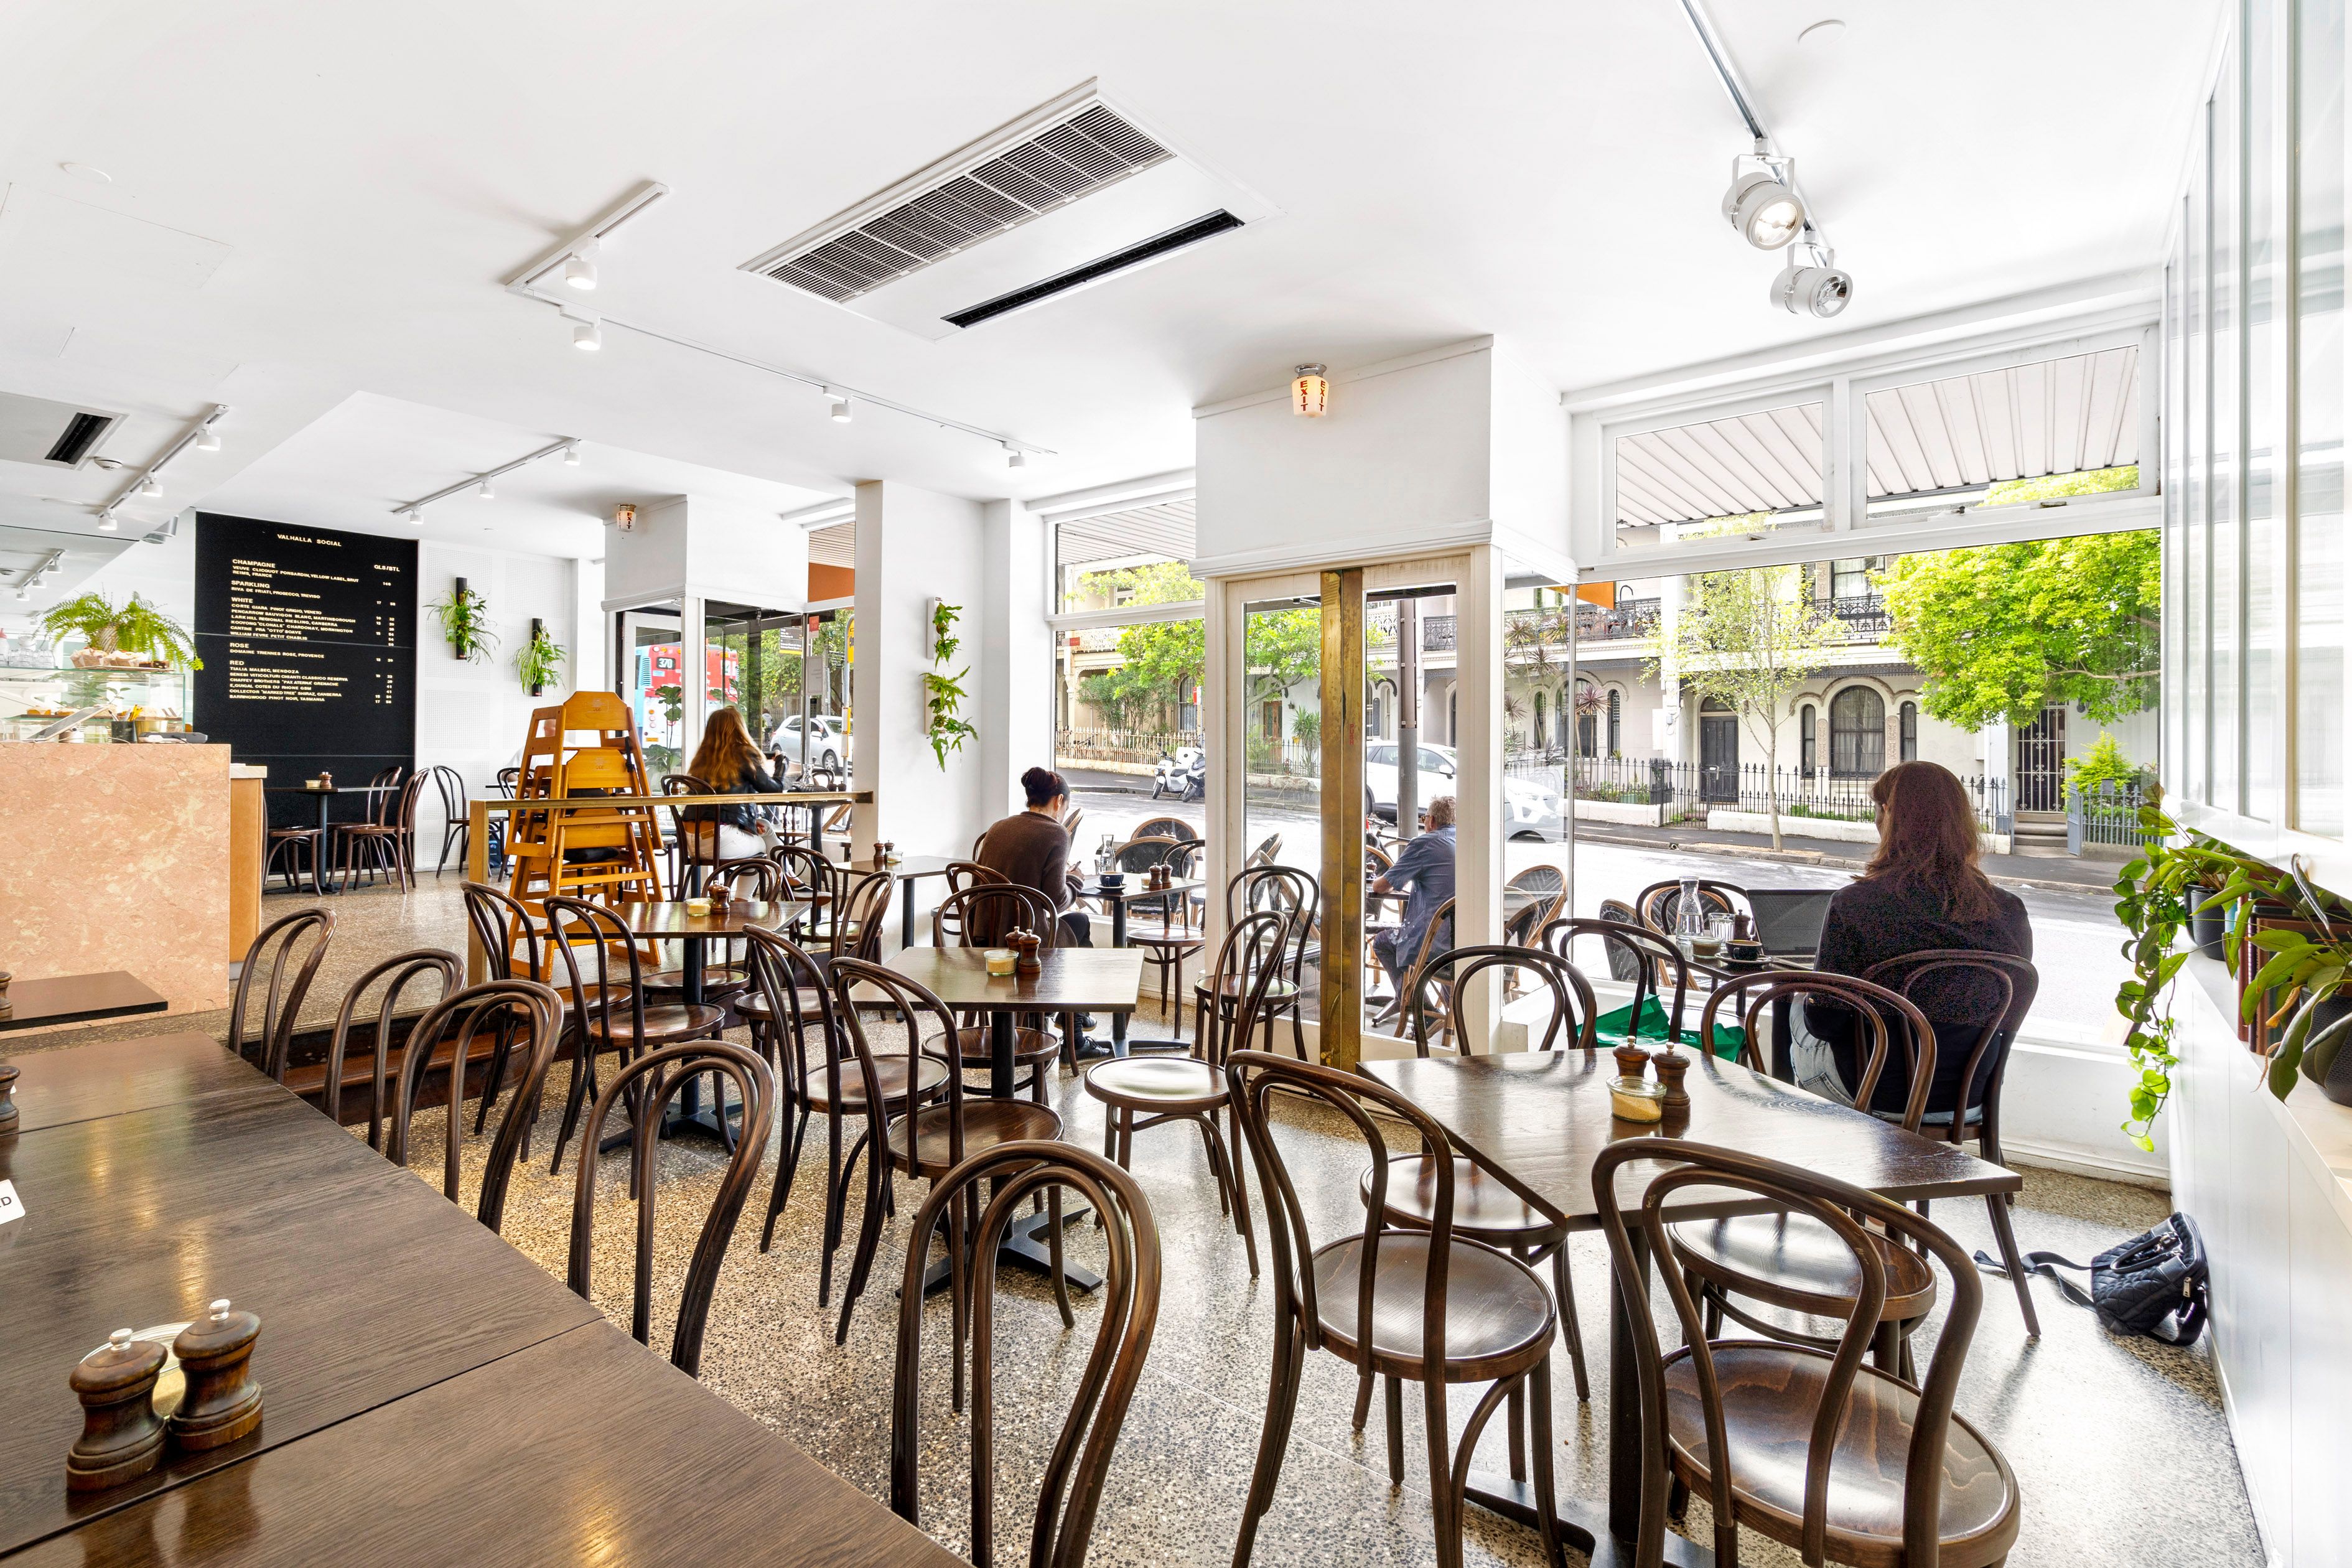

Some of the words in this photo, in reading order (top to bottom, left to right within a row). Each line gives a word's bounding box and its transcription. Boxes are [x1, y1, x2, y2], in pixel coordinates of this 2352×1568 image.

[1300, 380, 1308, 411] EXIT
[277, 534, 312, 543] VALHALLA
[232, 559, 276, 568] CHAMPAGNE
[658, 658, 673, 668] 370
